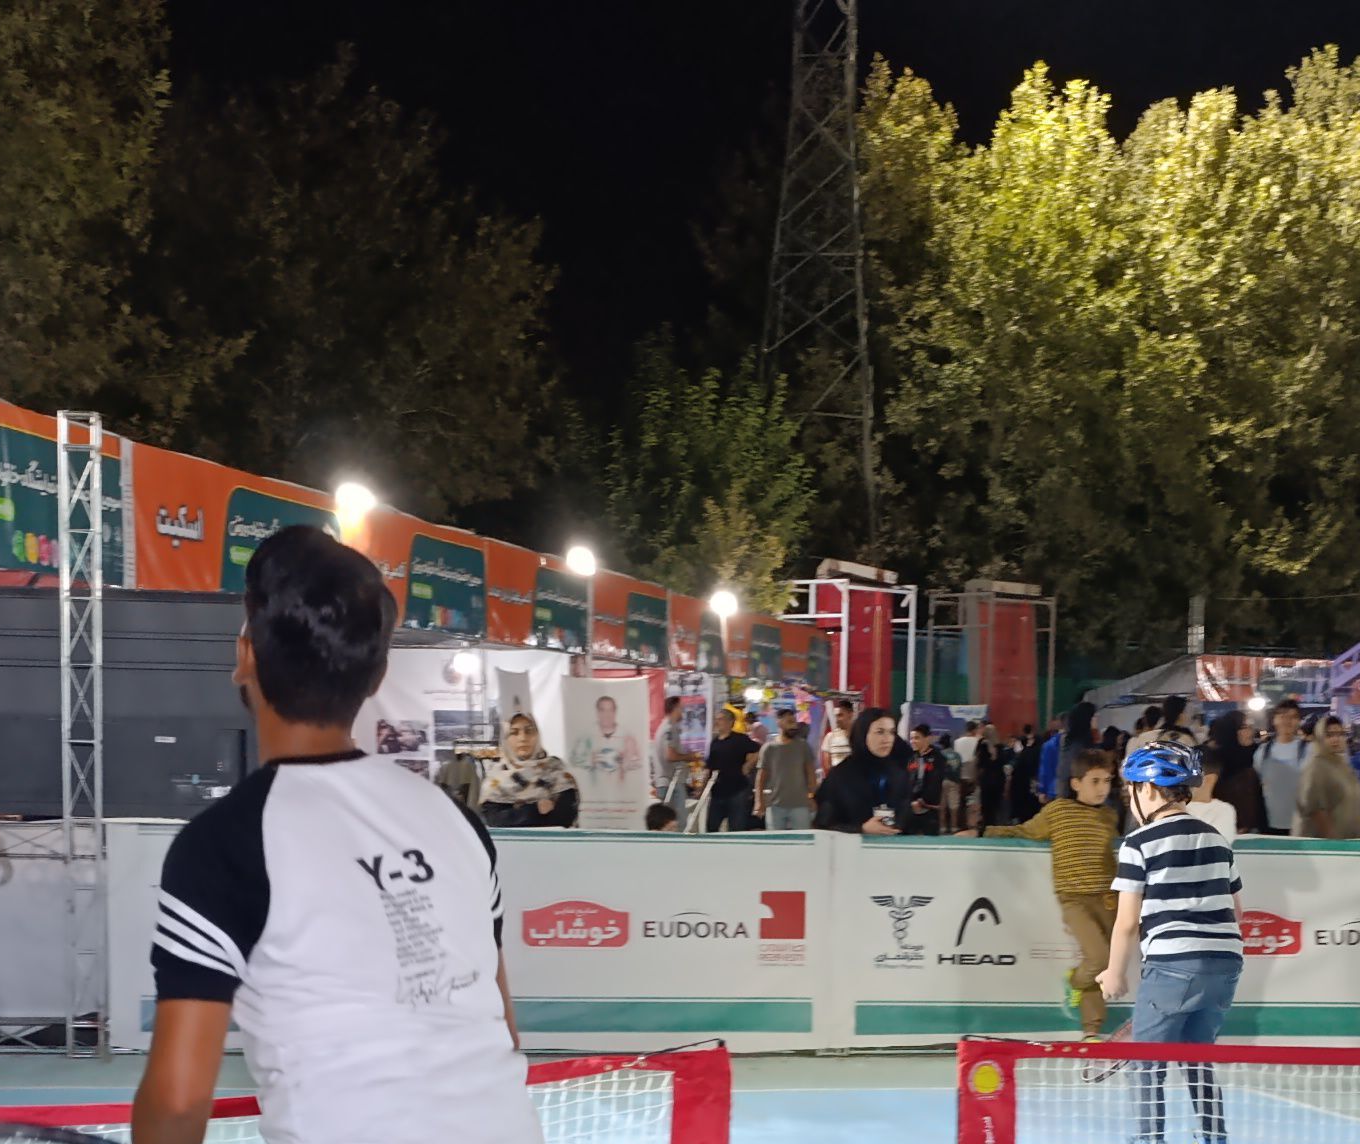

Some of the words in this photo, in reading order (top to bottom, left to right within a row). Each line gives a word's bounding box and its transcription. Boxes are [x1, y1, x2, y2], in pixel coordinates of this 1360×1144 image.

[155, 504, 205, 548] اسکیت
[356, 849, 435, 891] Y-3
[529, 917, 622, 946] خوشاب
[643, 918, 750, 939] EUDORA
[1242, 927, 1296, 954] خوش
[937, 953, 1018, 967] HEAD
